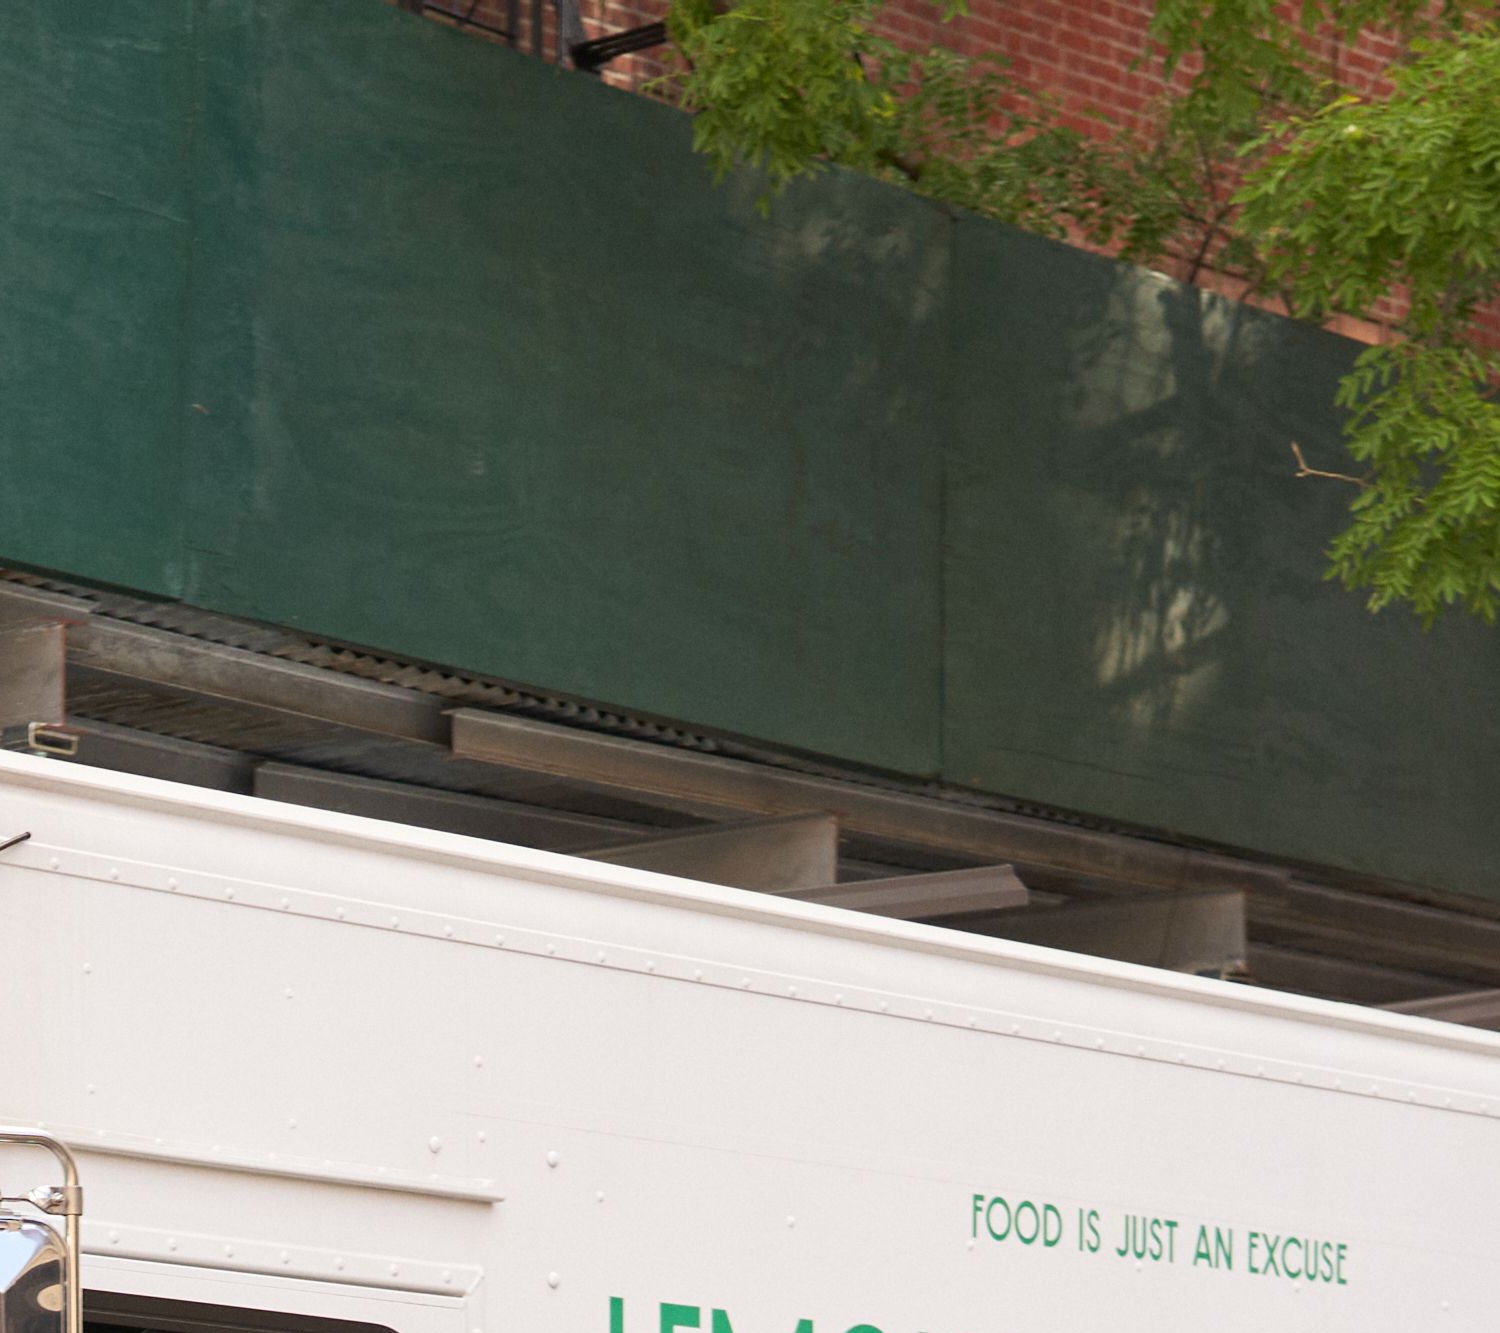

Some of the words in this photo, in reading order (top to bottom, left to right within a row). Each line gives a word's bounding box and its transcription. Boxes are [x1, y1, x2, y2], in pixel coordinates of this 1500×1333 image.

[971, 1195, 1063, 1250] FOOD
[1079, 1211, 1101, 1255] IS
[1116, 1216, 1179, 1263] JUST
[1192, 1226, 1235, 1271] AN
[1247, 1232, 1349, 1287] EXCUSE
